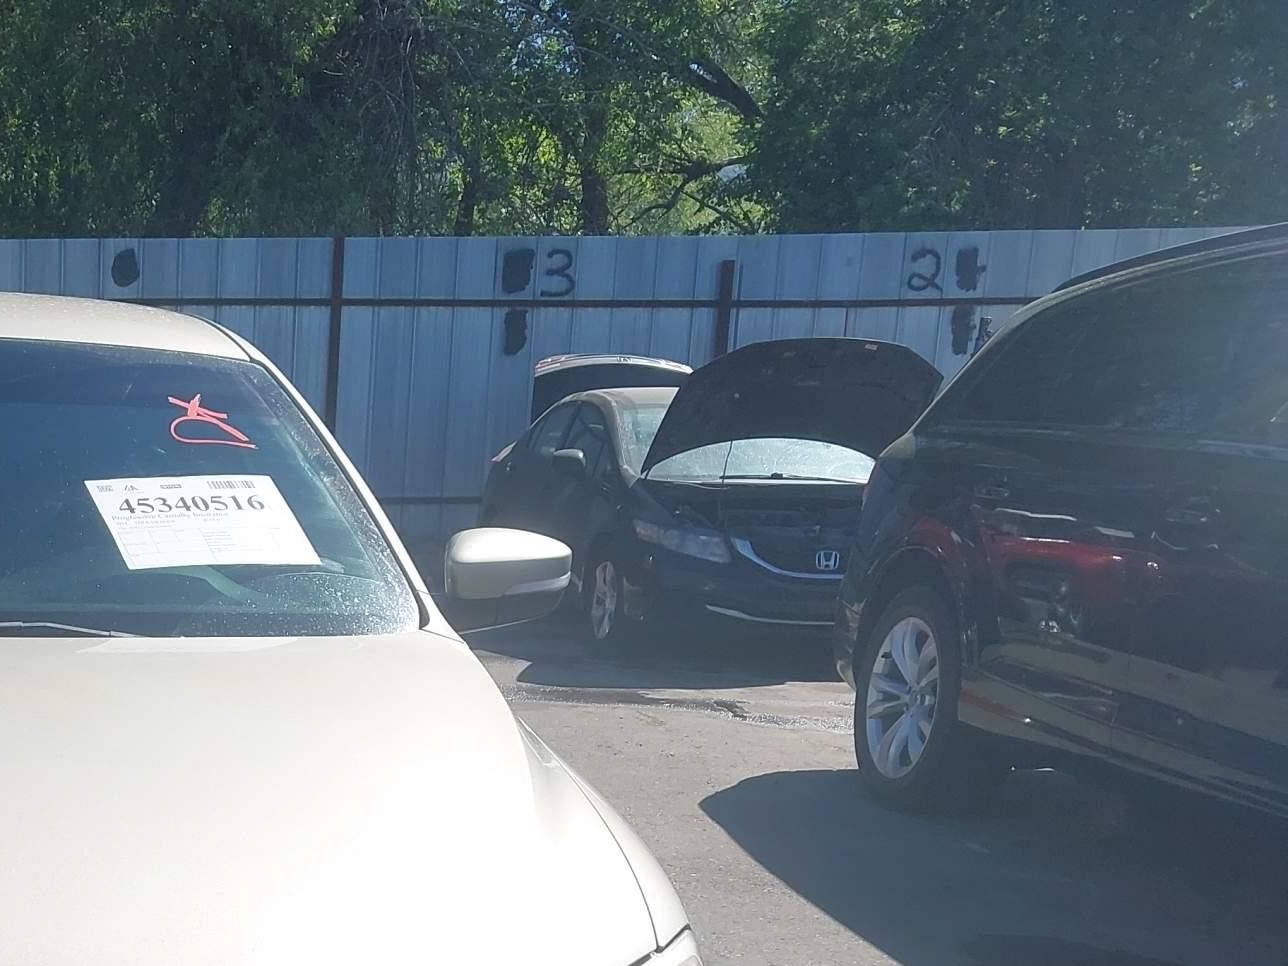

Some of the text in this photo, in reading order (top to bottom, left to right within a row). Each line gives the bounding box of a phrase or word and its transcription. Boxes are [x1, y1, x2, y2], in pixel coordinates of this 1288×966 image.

[540, 248, 576, 298] 3
[907, 247, 943, 296] 2
[118, 493, 266, 515] 45340516
